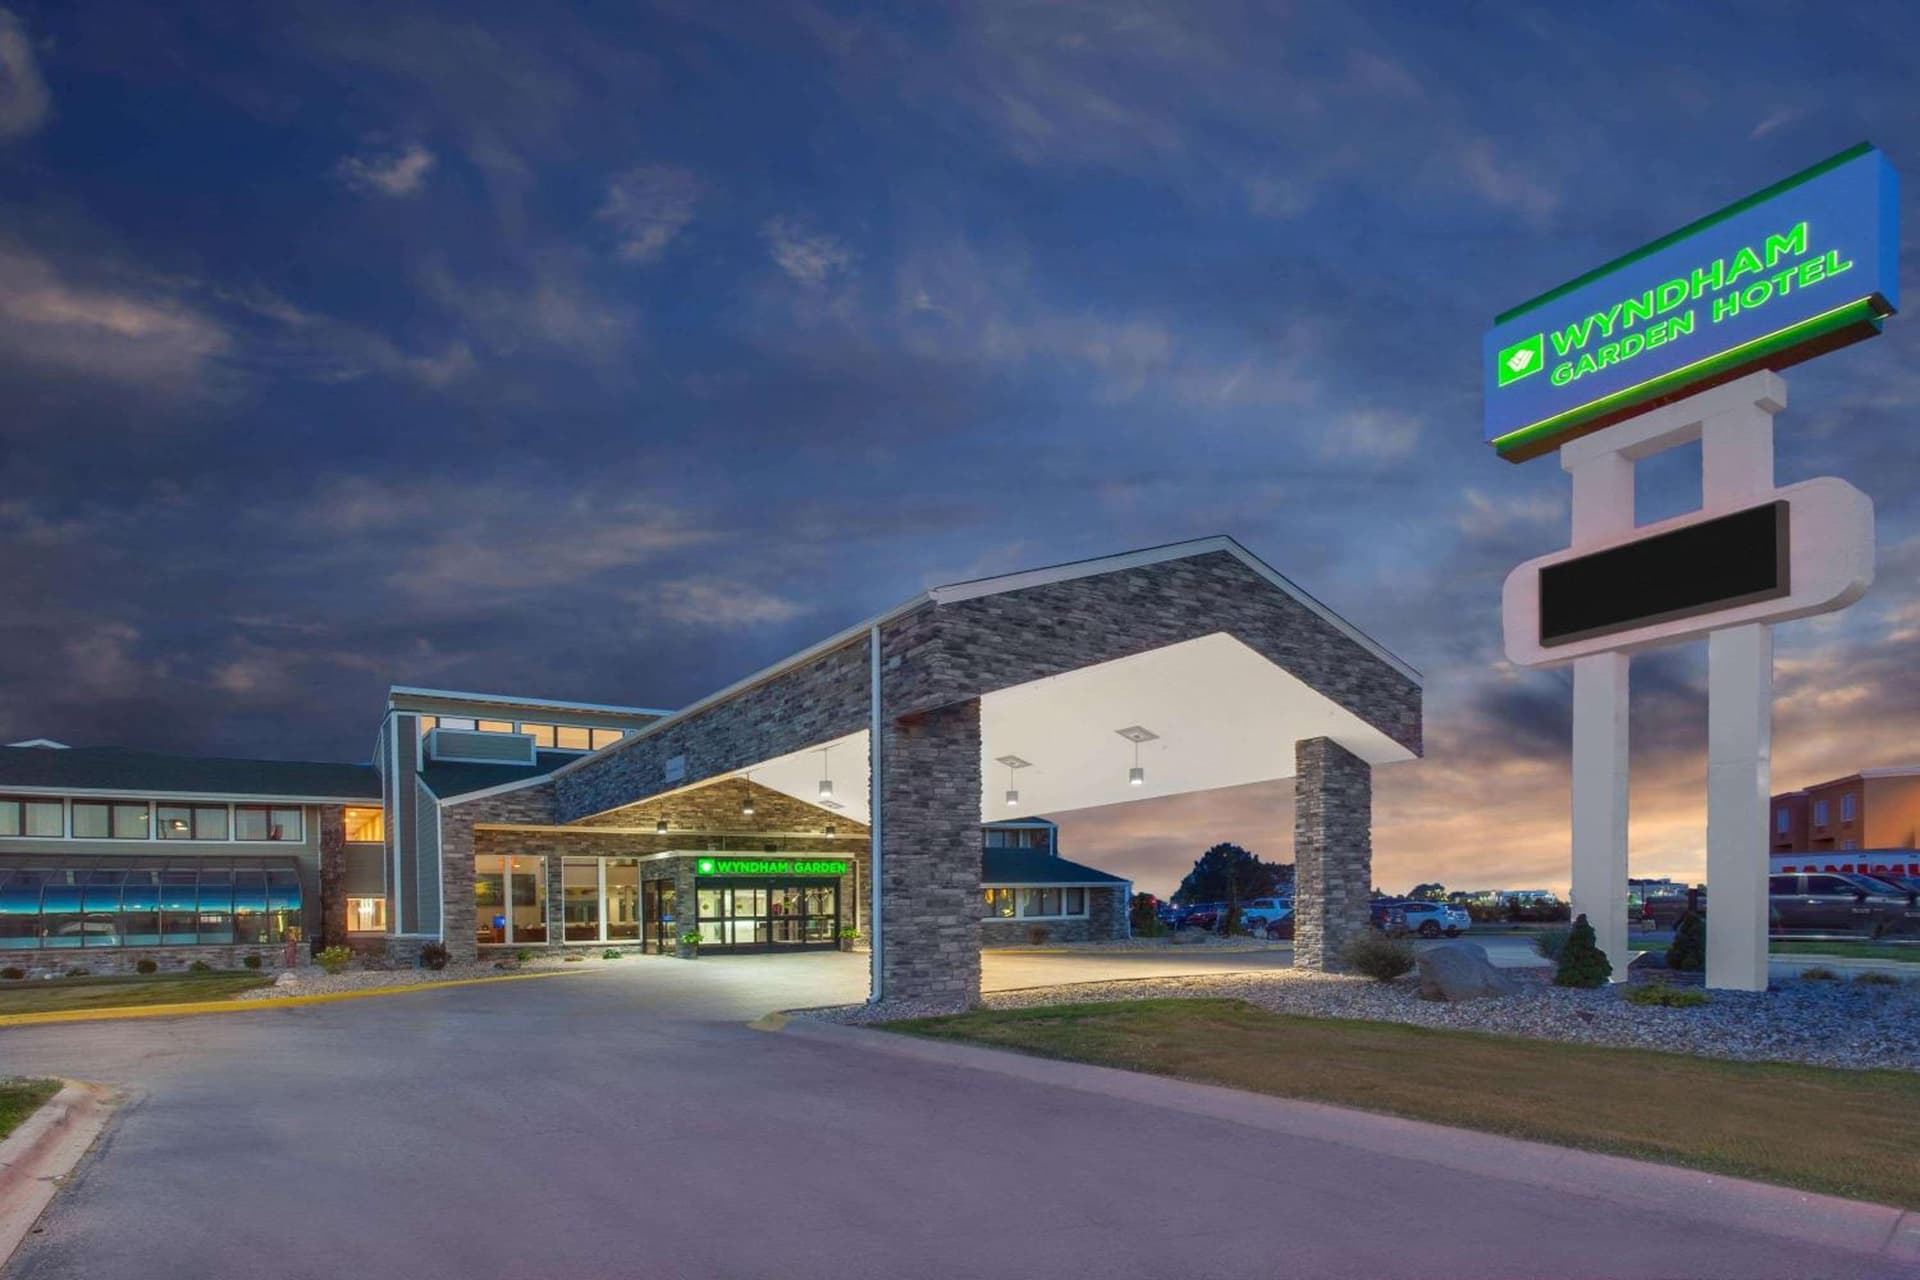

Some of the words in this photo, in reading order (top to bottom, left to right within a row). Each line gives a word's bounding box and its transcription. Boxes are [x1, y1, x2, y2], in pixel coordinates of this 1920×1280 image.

[1550, 222, 1808, 356] WYNDHAM
[1551, 311, 1695, 386] GARDEN
[1712, 249, 1853, 323] HOTEL
[717, 861, 788, 873] WYNDHAM
[794, 861, 846, 874] GARDEN
